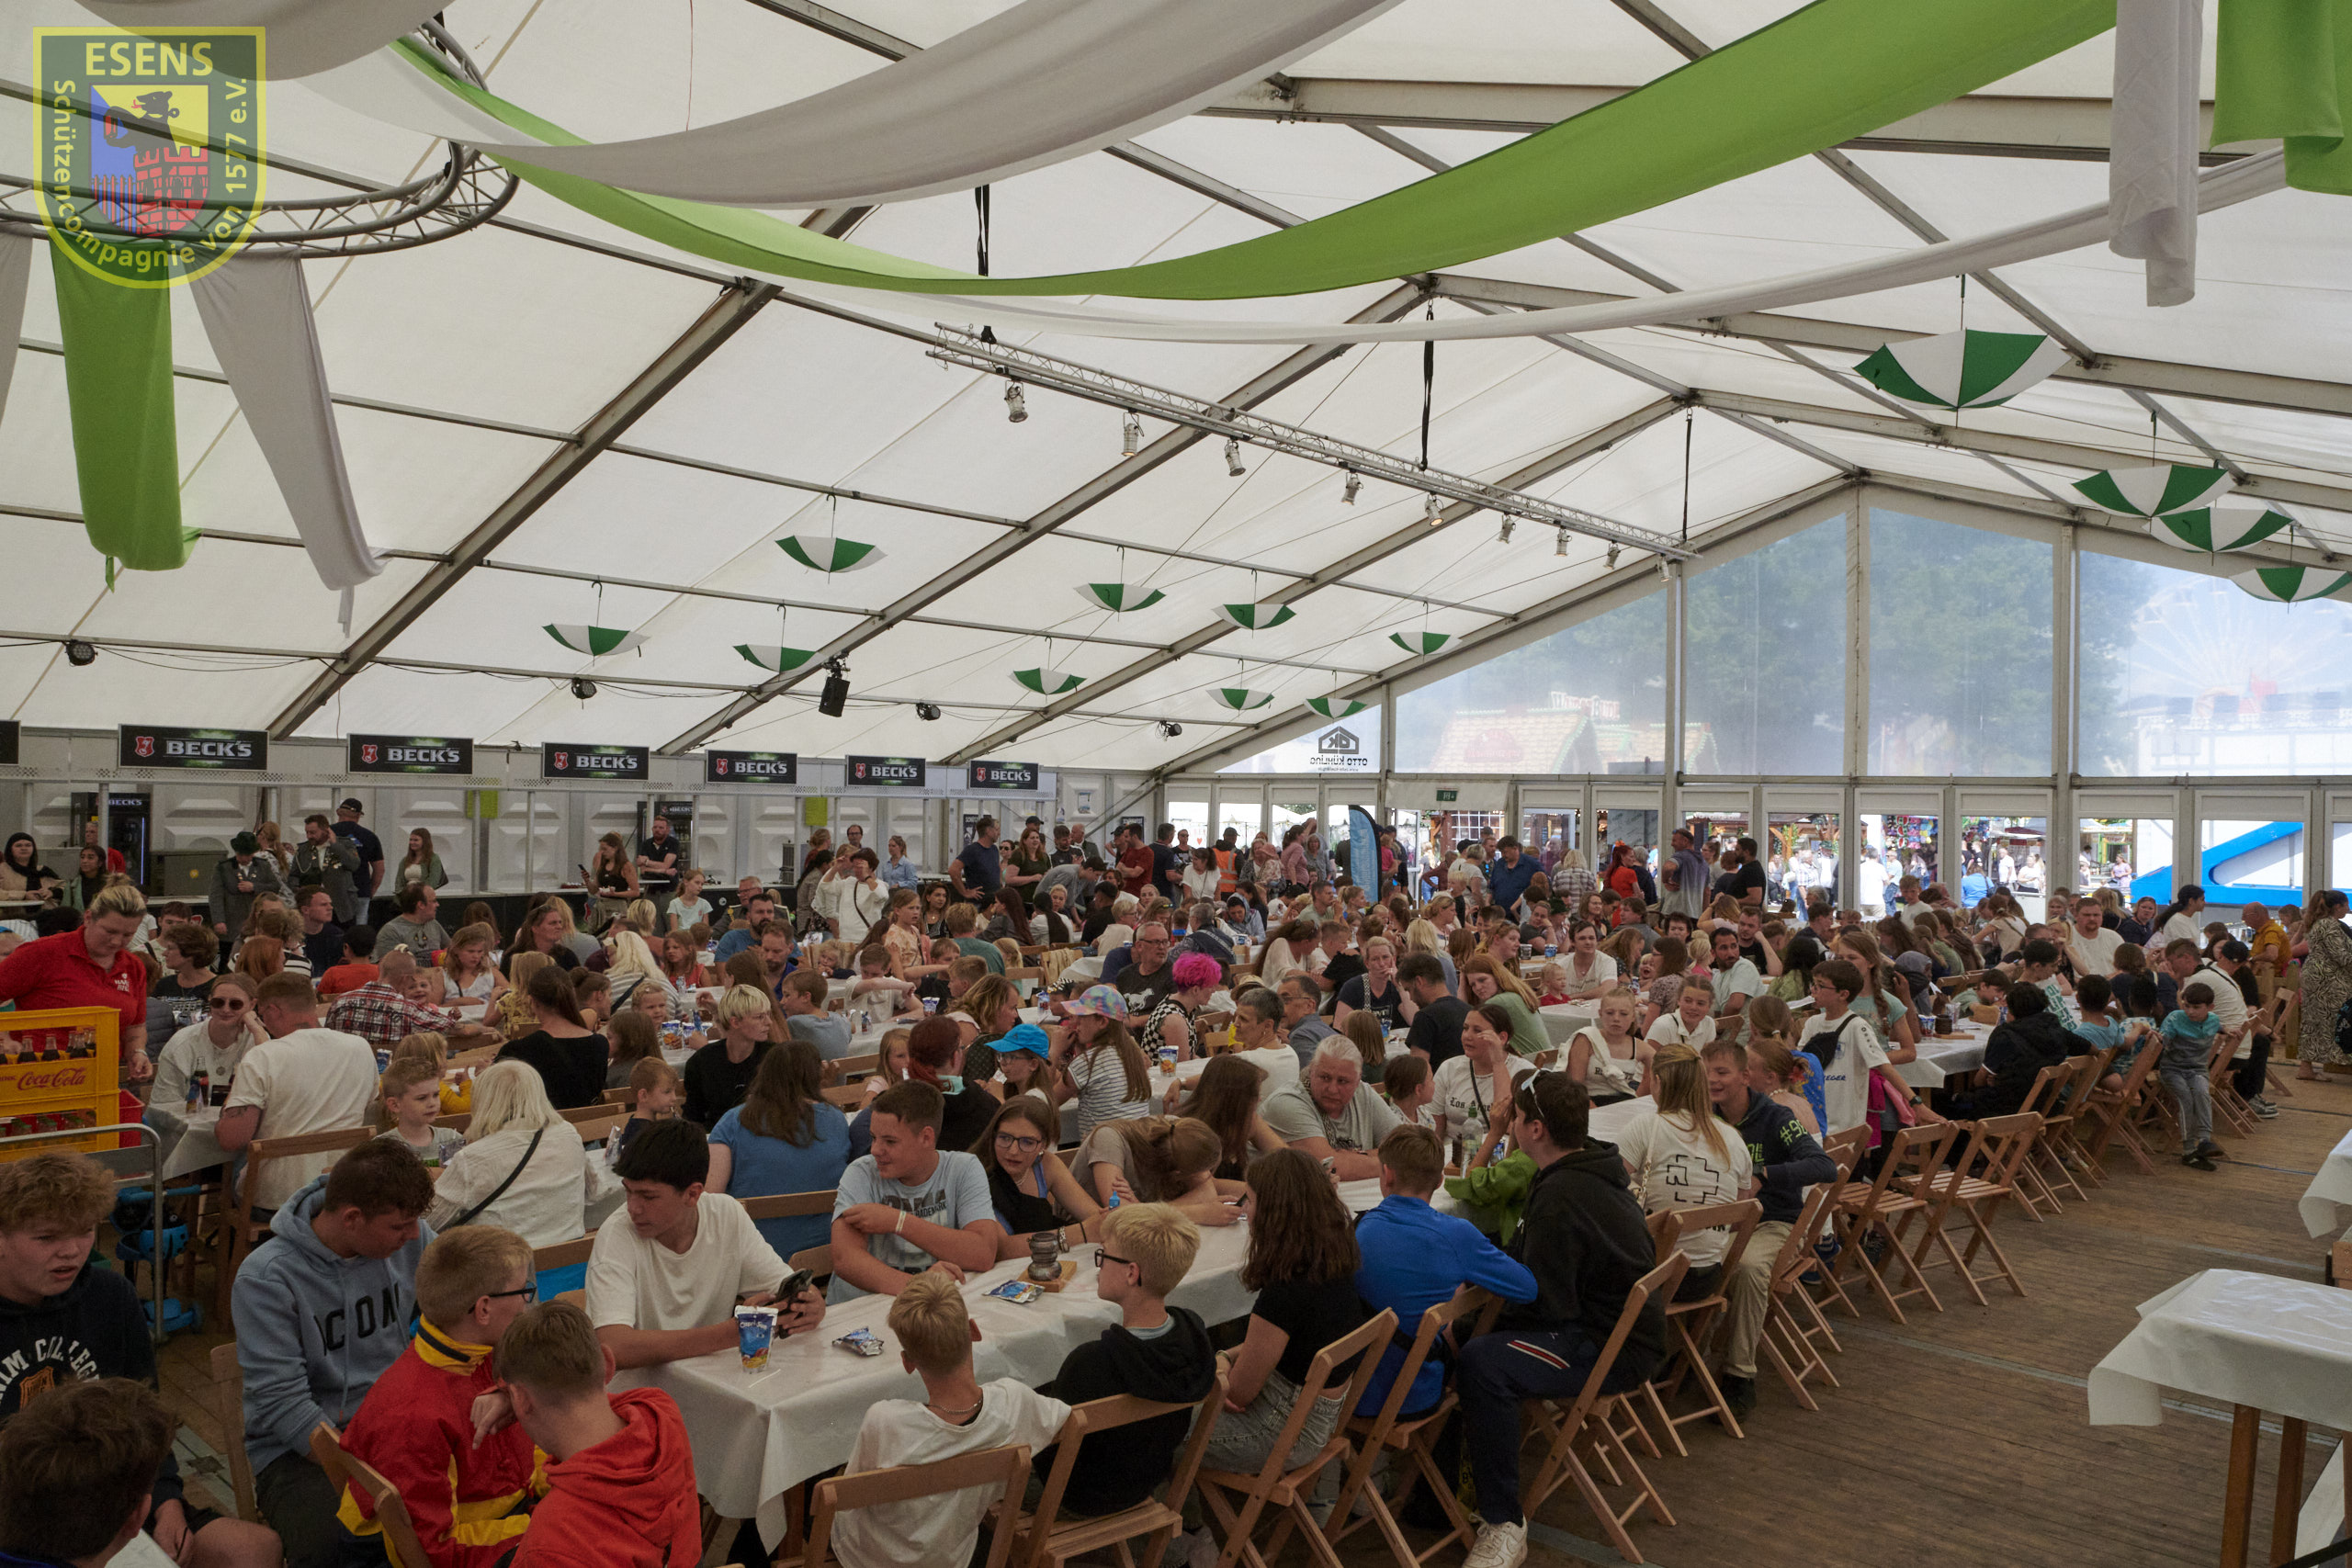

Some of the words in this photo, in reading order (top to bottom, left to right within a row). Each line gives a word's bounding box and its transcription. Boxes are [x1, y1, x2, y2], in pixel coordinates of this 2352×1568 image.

[166, 739, 252, 757] BECK'S
[387, 747, 460, 762] BECK'S
[575, 754, 638, 769] BECK'S
[735, 761, 787, 774] BECK'S
[871, 765, 917, 778] BECK'S
[990, 770, 1031, 781] BECK'S
[17, 1067, 86, 1090] Coca-Cola
